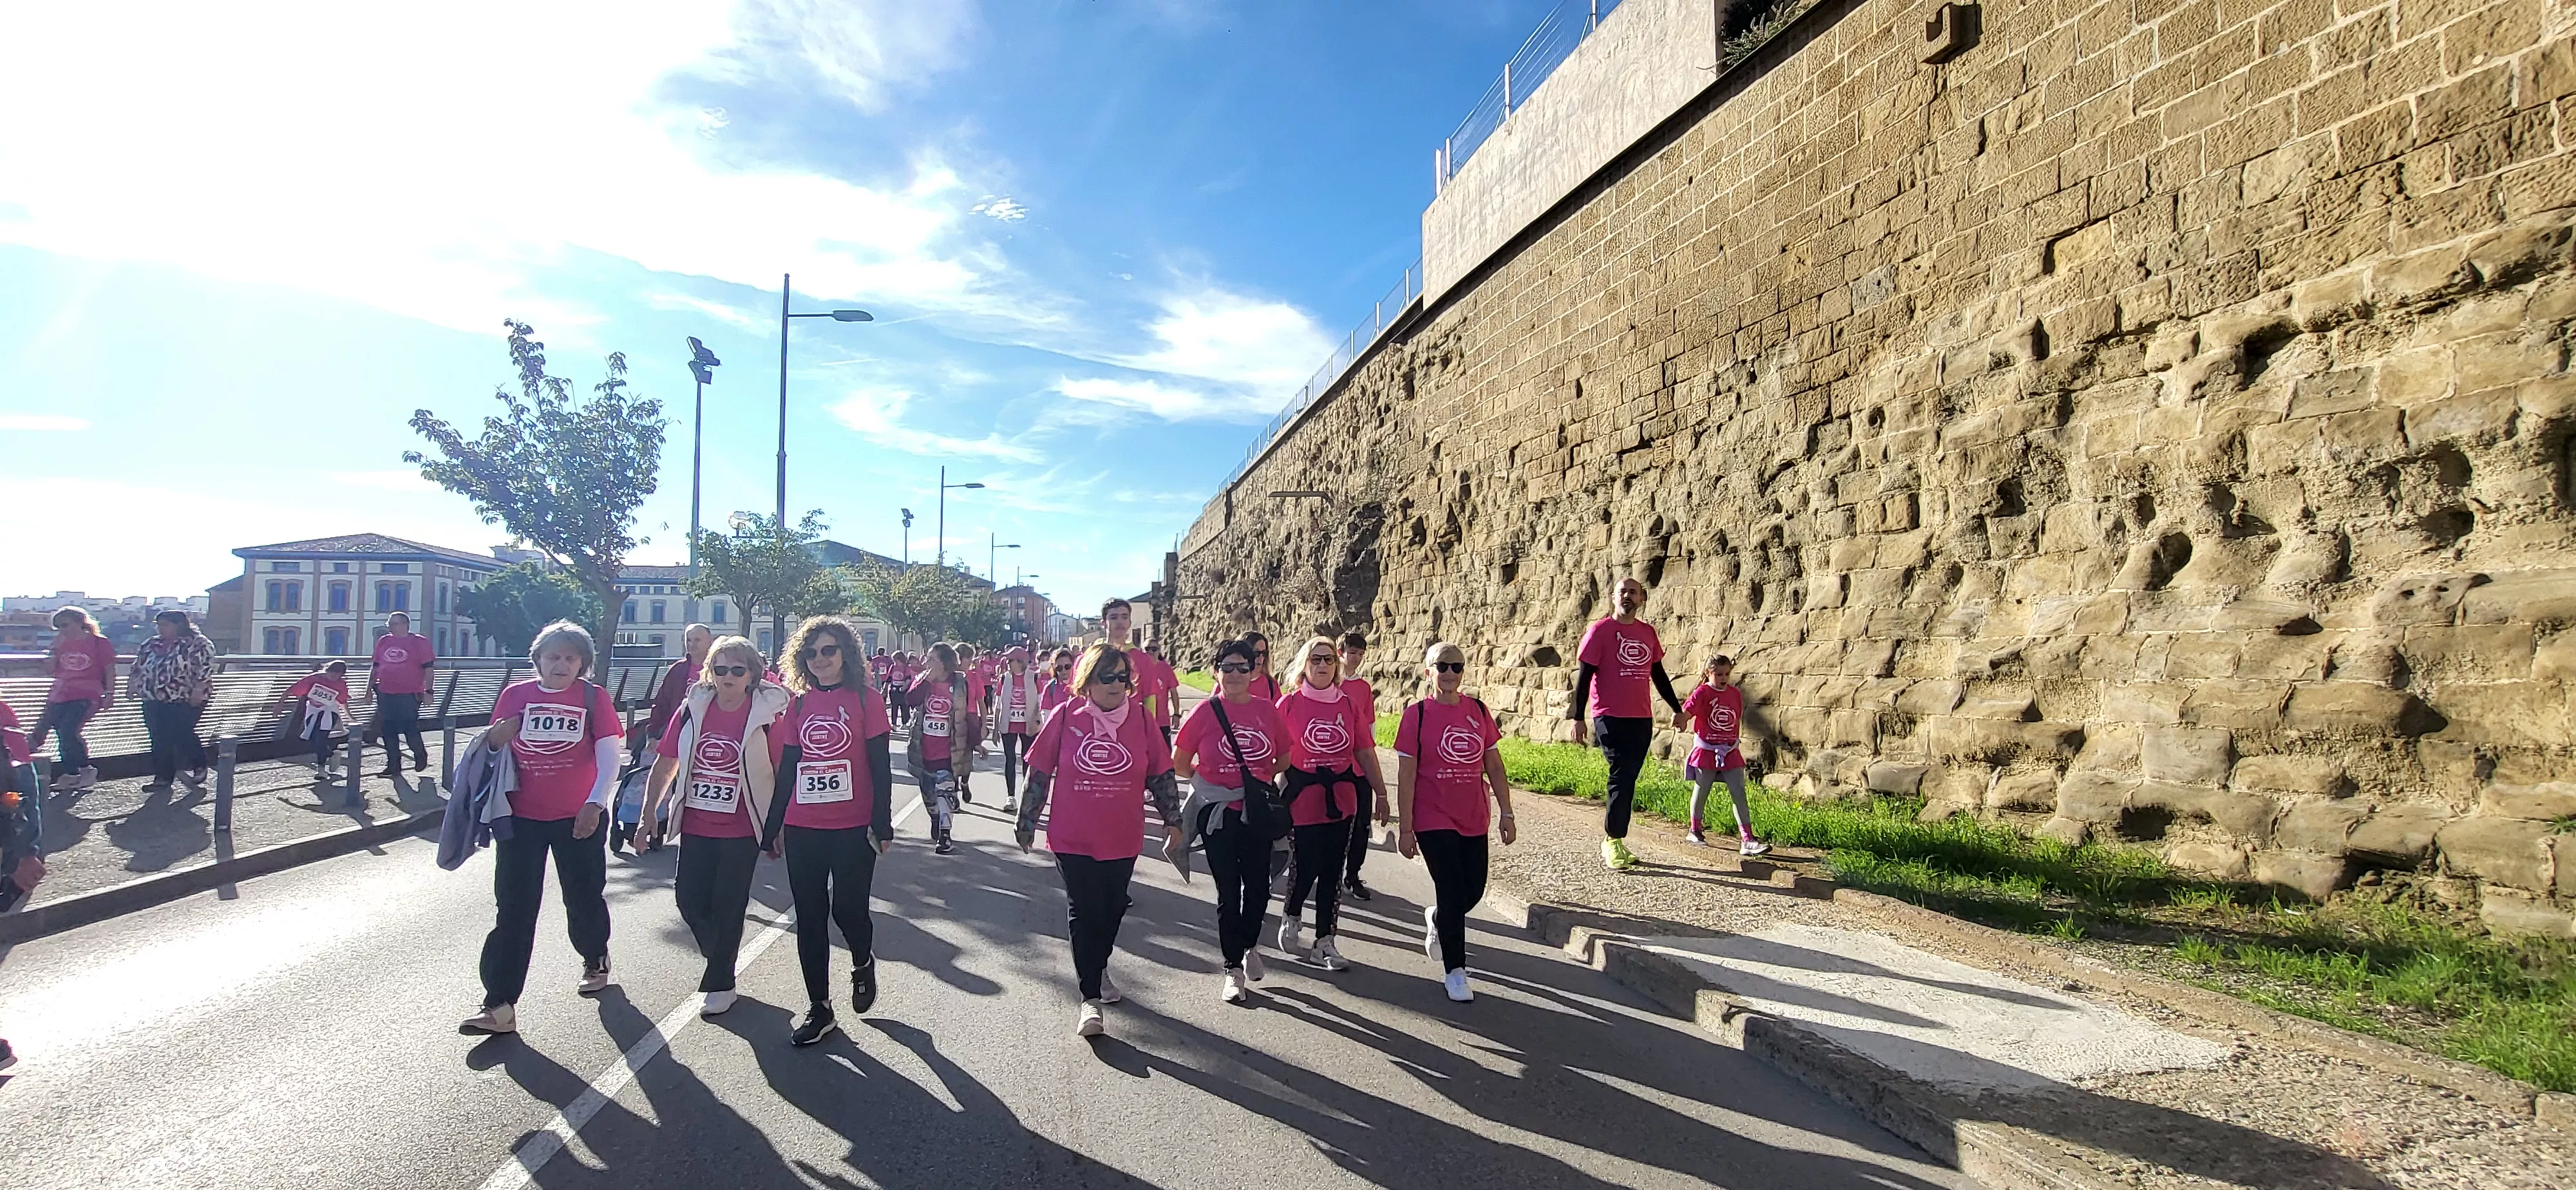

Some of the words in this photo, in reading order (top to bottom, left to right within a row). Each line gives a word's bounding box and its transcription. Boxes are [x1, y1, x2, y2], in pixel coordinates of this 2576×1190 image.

[530, 716, 578, 731] 1018
[927, 722, 945, 731] 458
[806, 774, 840, 791] 356
[692, 783, 734, 801] 1233
